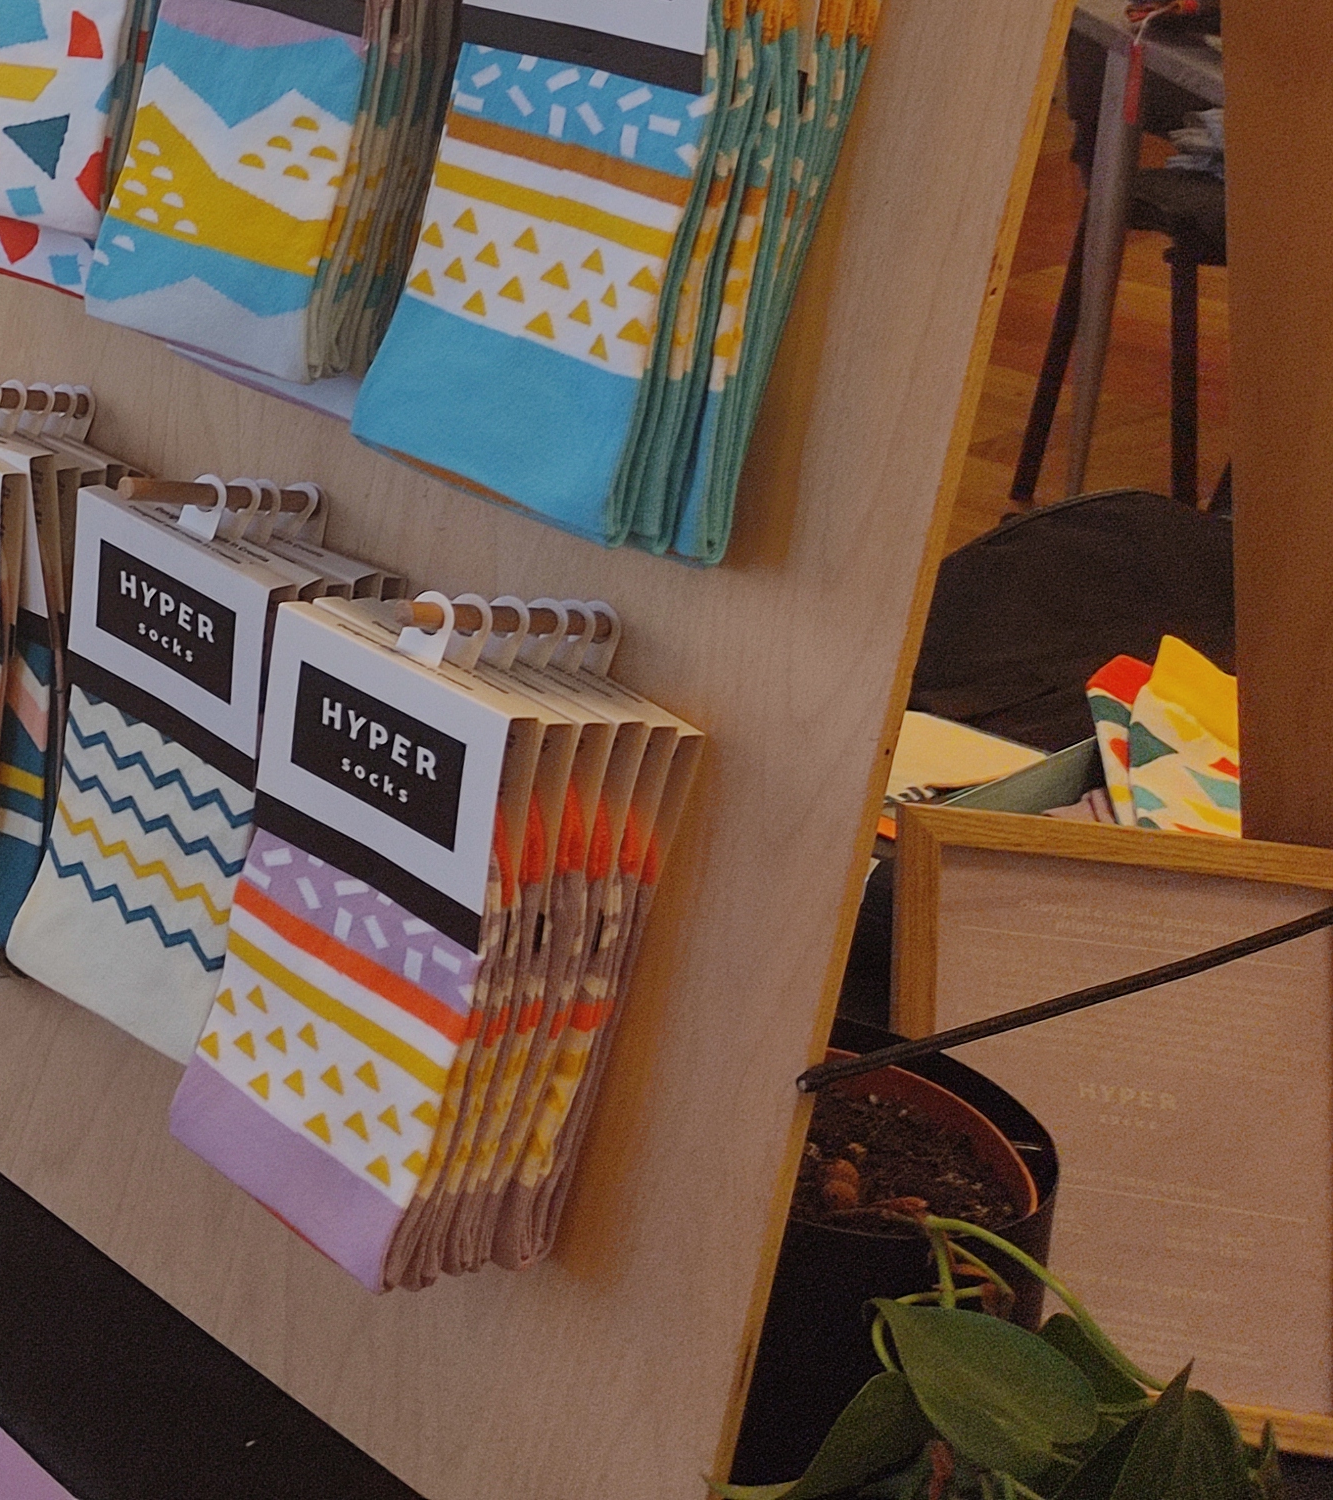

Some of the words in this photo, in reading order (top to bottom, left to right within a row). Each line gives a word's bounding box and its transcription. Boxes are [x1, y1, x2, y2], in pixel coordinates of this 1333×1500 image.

[119, 569, 215, 644] HYPER
[138, 622, 194, 663] socks
[321, 697, 437, 781] HYPER
[340, 757, 409, 803] socks
